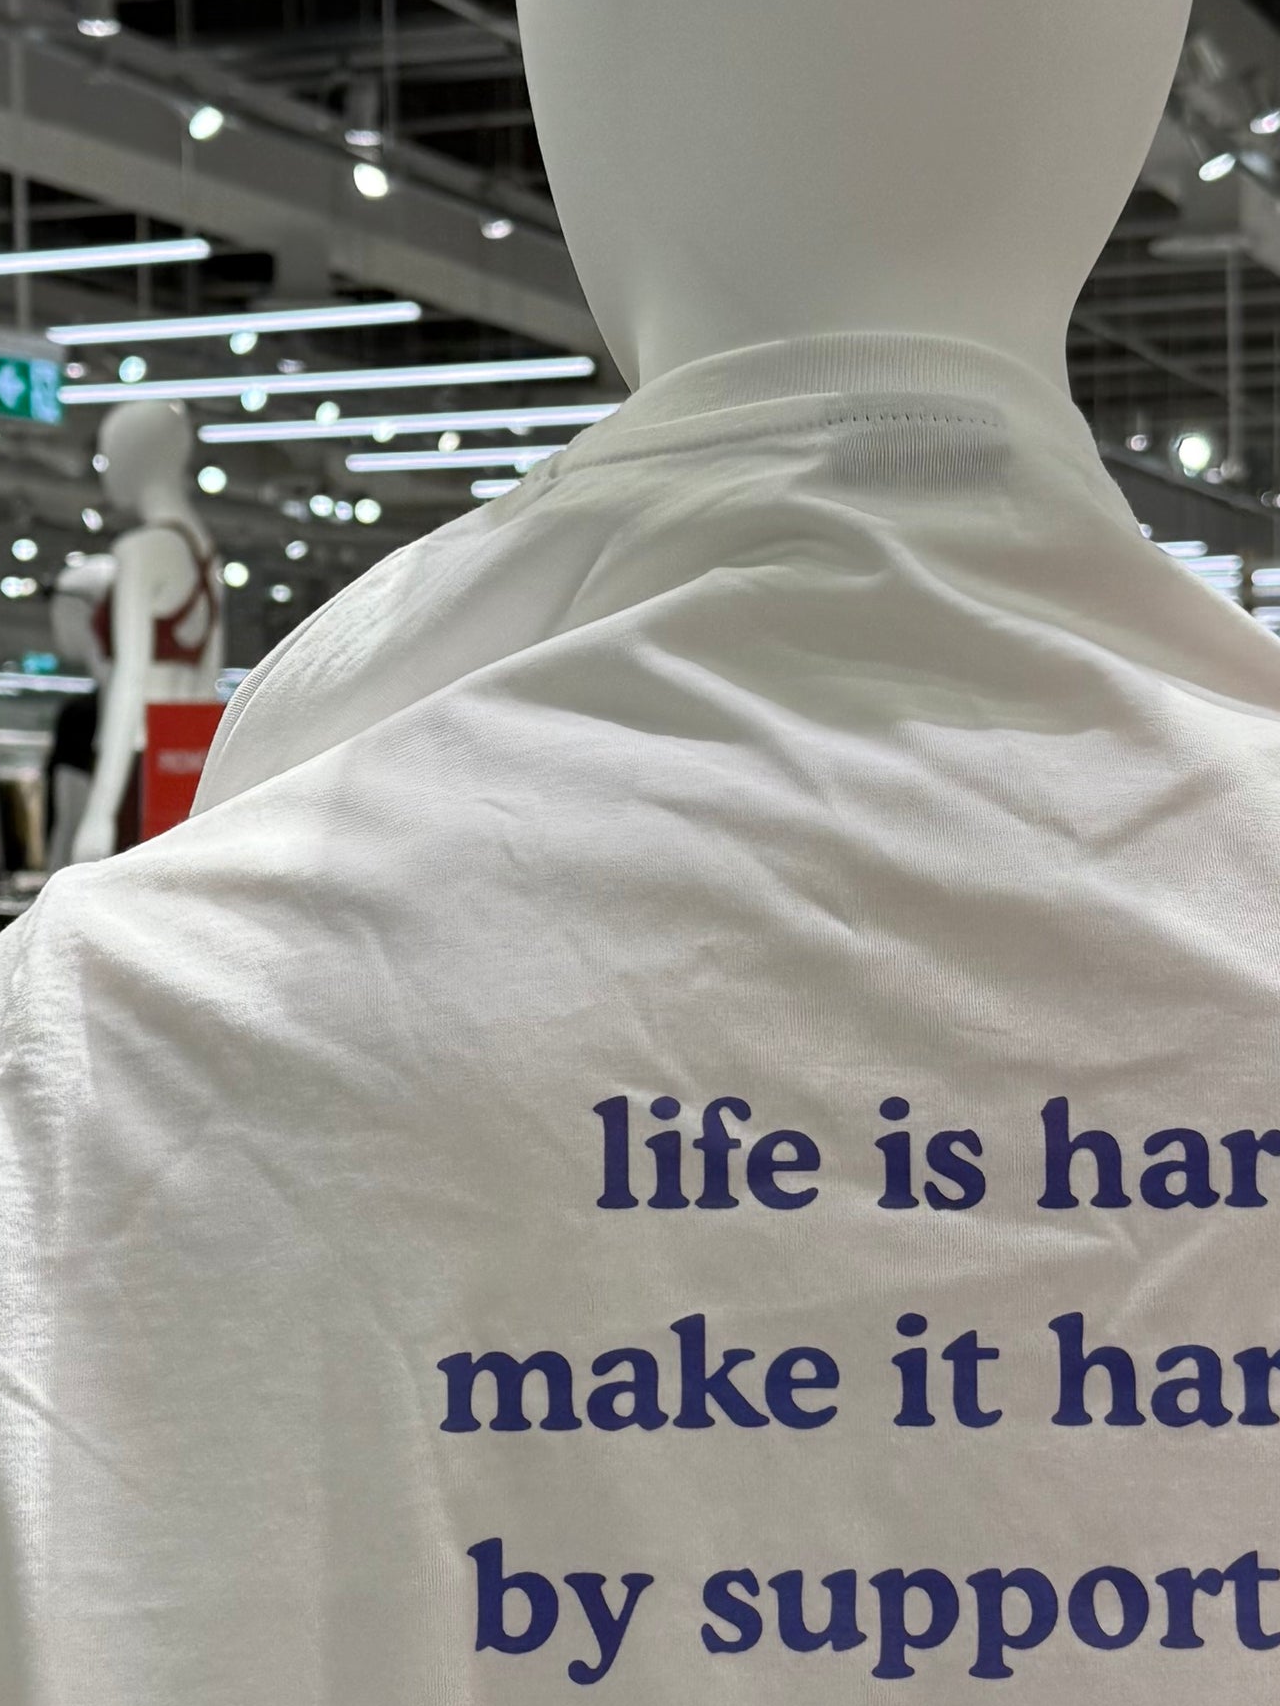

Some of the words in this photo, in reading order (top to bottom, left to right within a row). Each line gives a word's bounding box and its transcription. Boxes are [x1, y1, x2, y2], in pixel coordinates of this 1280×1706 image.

[592, 1096, 822, 1210] life
[876, 1096, 987, 1210] is
[436, 1313, 841, 1433] make
[890, 1312, 1002, 1429] it
[466, 1537, 654, 1686] by
